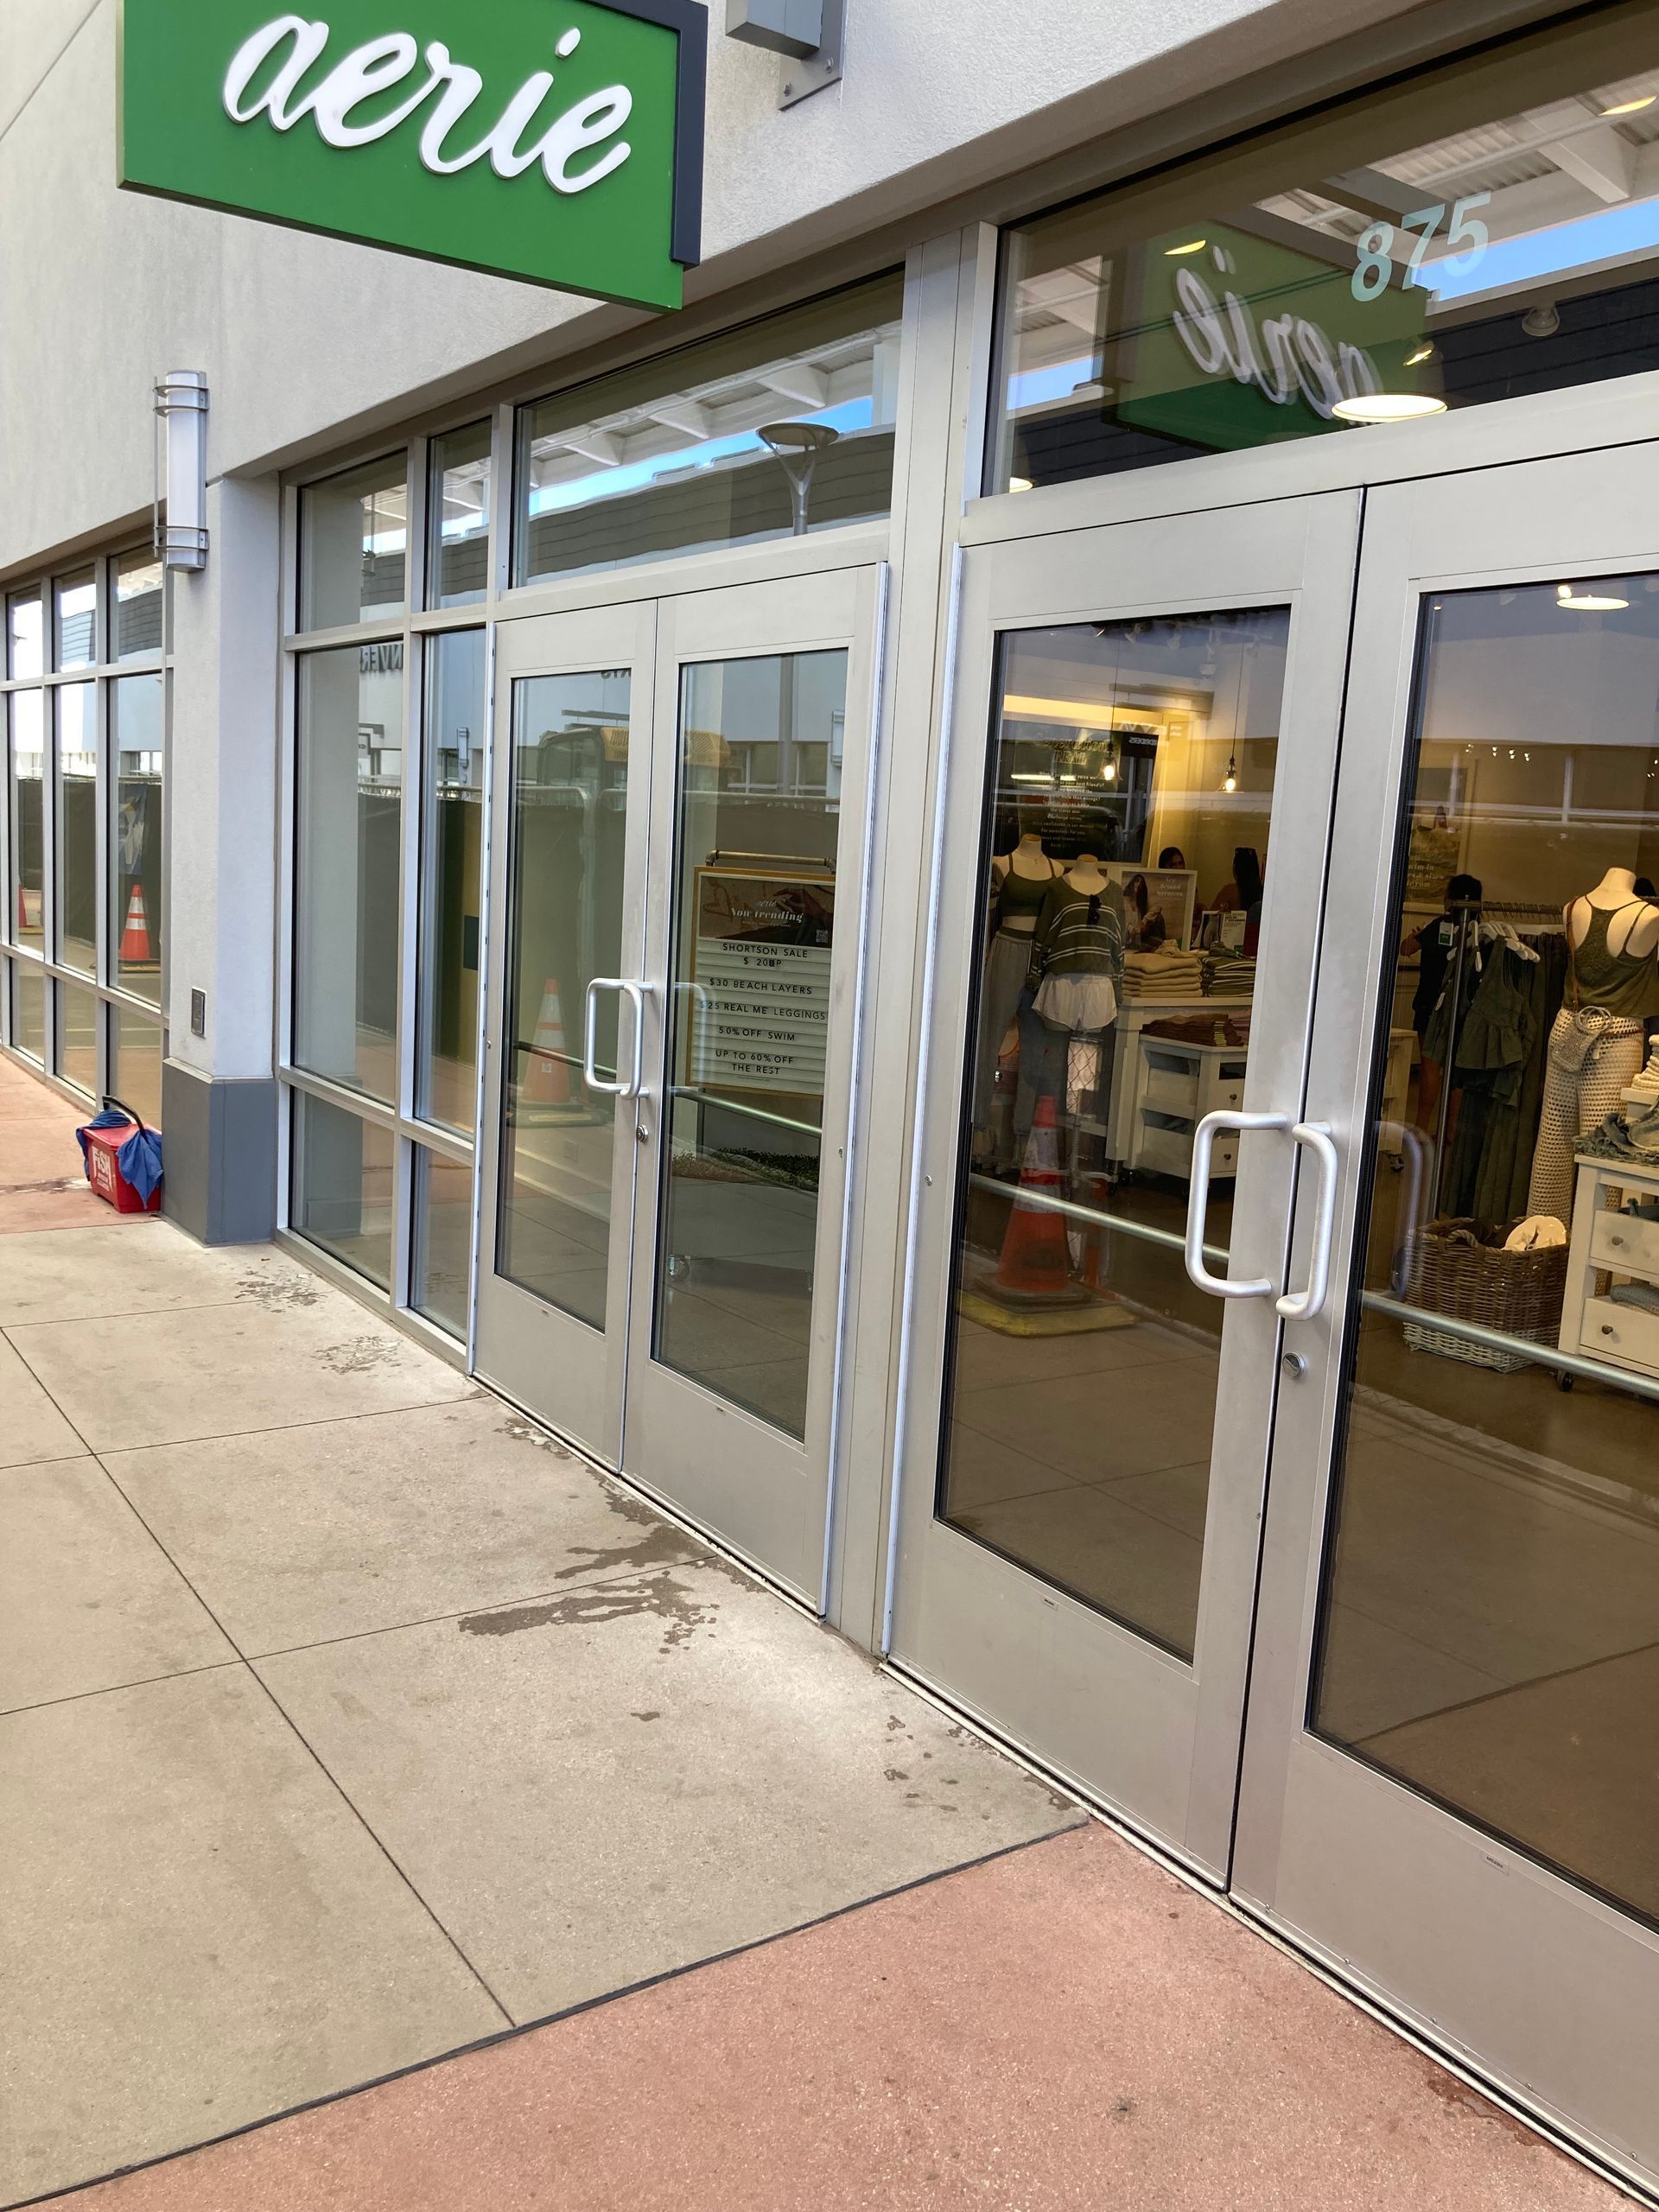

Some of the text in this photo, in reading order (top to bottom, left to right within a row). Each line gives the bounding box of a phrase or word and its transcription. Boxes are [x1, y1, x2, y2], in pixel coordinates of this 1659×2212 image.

[222, 15, 632, 194] aerie
[1351, 191, 1491, 302] 875
[731, 907, 752, 918] Now
[754, 910, 804, 924] trending
[784, 948, 808, 958] SALE
[709, 977, 812, 995] $30 BEACH LAYERS
[724, 1002, 748, 1013] REAL
[753, 1006, 767, 1014] ME
[773, 1007, 825, 1020] LEGGINGS
[767, 1032, 795, 1041] SWIM
[732, 1052, 747, 1060] TO
[732, 1063, 780, 1075] THE REST
